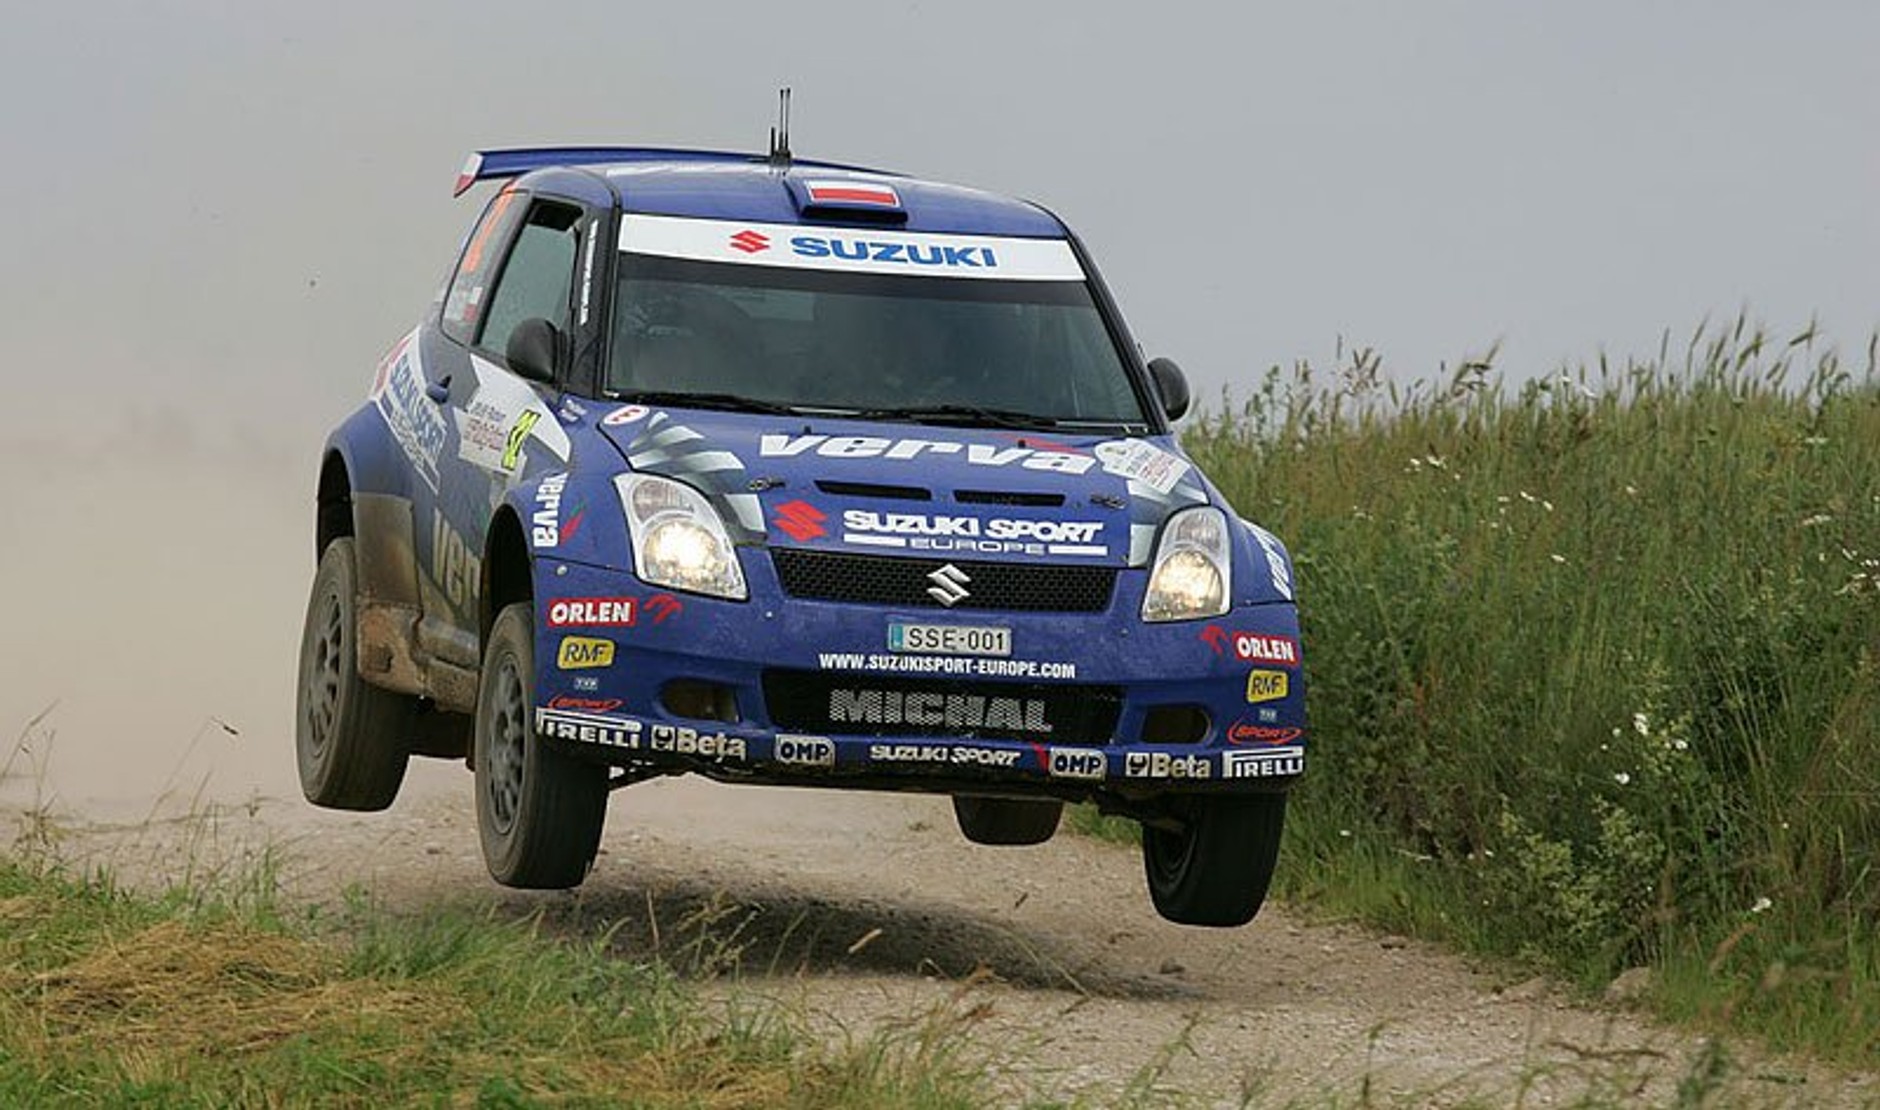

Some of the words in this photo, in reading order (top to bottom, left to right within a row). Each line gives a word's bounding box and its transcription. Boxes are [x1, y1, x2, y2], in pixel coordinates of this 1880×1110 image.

[790, 237, 997, 267] SUZUKI
[760, 435, 1096, 474] verva
[533, 472, 568, 547] verva
[844, 510, 979, 537] SUZUKI
[985, 520, 1103, 542] SPORT
[911, 538, 1045, 556] EUROPE
[550, 602, 630, 623] ORLEN
[909, 627, 1004, 650] SSE-001
[1237, 637, 1295, 661] ORLEN
[564, 643, 608, 662] RMF
[819, 653, 1076, 678] WWW.SUZUKISPORT-EUROPE.COM
[1252, 675, 1282, 695] RMF
[829, 689, 1053, 733] MICHAL
[536, 708, 642, 748] PIRELLI
[676, 728, 746, 762] Beta
[780, 742, 829, 761] OMP
[870, 746, 948, 761] SUZUKI
[951, 747, 1021, 766] SPORT
[1055, 755, 1101, 774] OMP
[1151, 753, 1211, 777] Beta
[1222, 746, 1304, 778] PIRELLI
